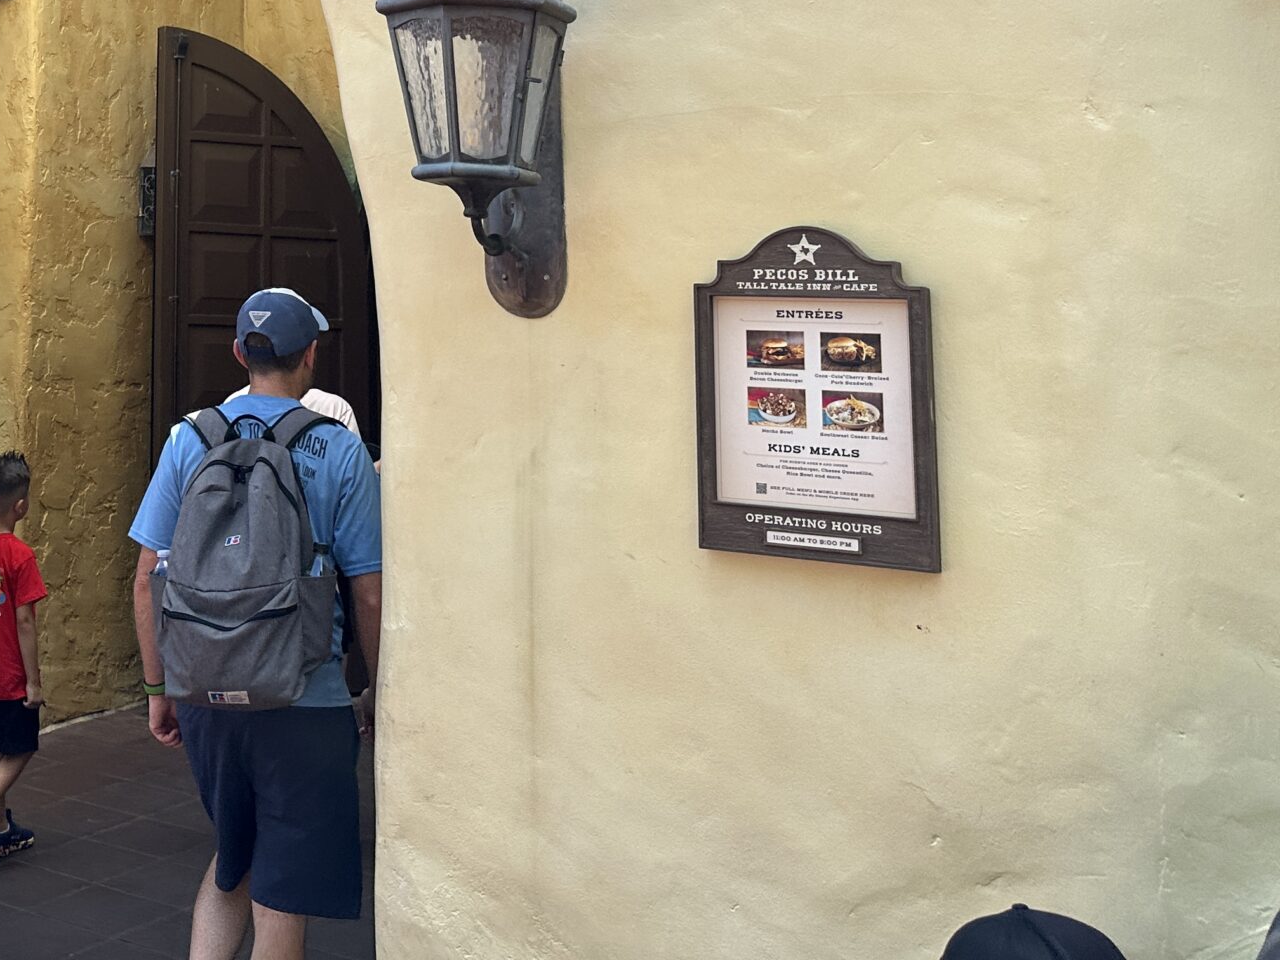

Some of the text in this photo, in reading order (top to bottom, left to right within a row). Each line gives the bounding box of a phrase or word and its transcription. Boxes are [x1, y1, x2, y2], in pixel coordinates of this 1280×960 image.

[753, 269, 859, 281] PECOS BILL
[736, 282, 768, 290] TALL
[769, 282, 804, 290] TALE
[806, 283, 832, 291] INN
[842, 283, 878, 292] CAFE
[776, 308, 844, 320] ENTRÉES
[809, 446, 861, 458] MEALS
[745, 513, 882, 535] OPERATING HOURS
[807, 537, 818, 545] TO
[839, 540, 852, 548] PM
